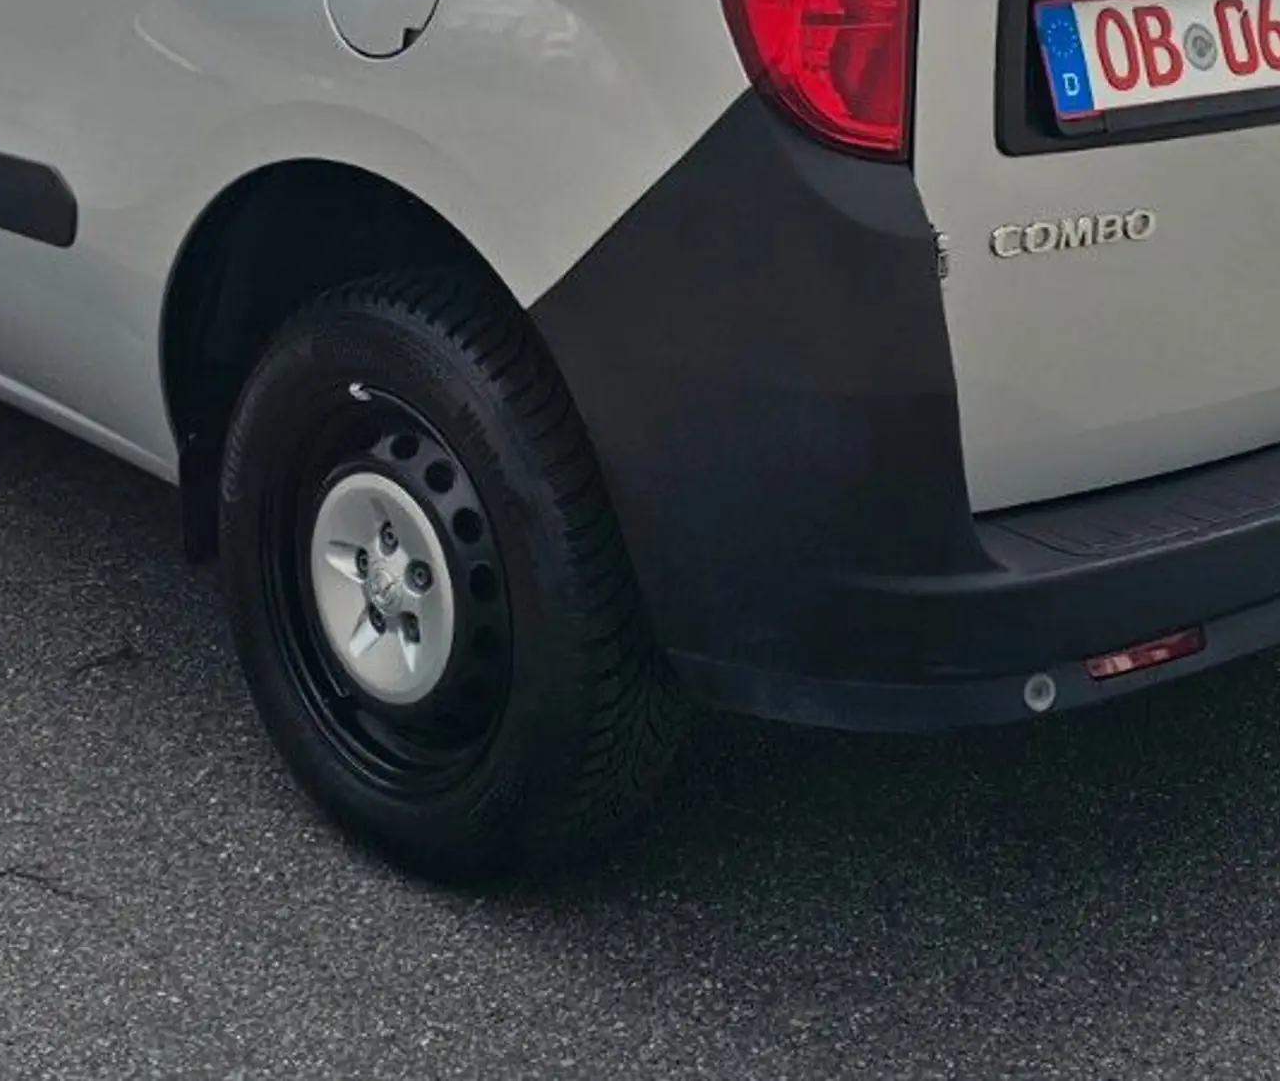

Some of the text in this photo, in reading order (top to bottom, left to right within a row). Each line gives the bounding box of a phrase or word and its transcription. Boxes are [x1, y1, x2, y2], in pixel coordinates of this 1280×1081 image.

[1095, 5, 1184, 91] OB
[1063, 72, 1081, 97] D
[990, 208, 1157, 258] COMBO
